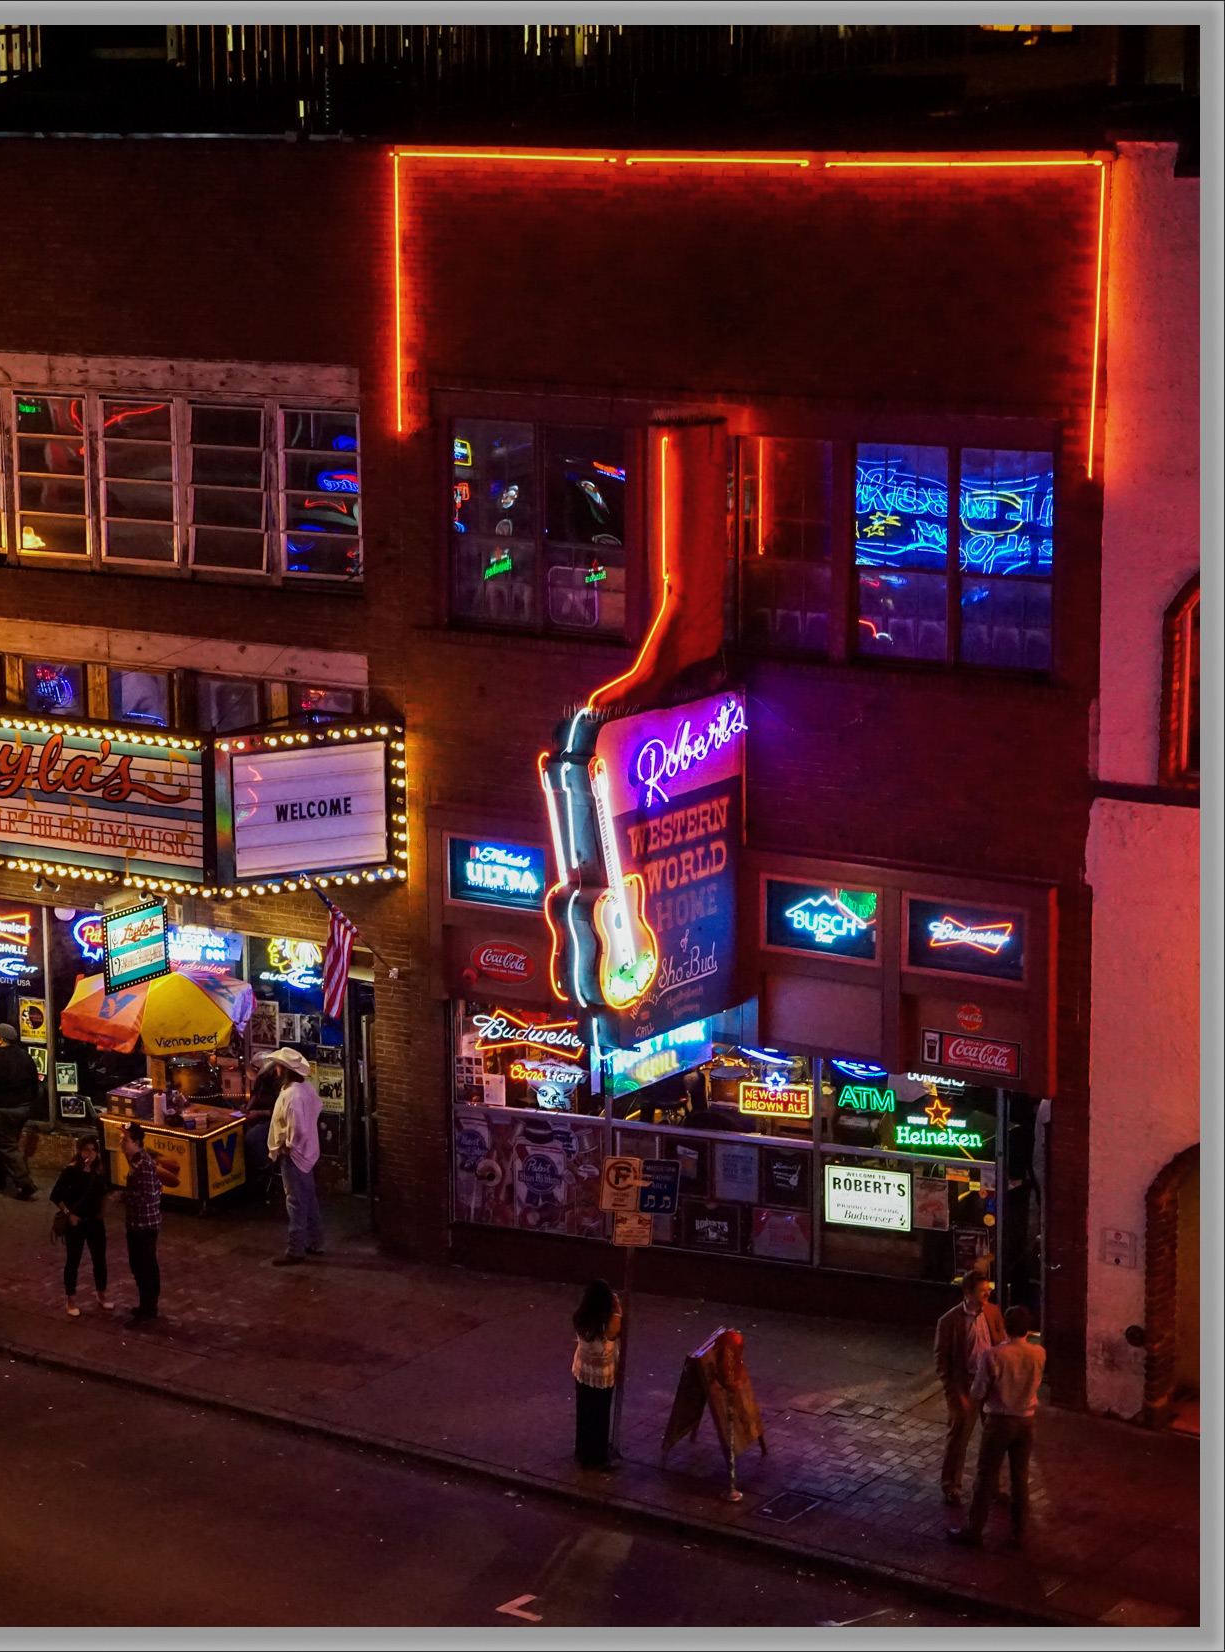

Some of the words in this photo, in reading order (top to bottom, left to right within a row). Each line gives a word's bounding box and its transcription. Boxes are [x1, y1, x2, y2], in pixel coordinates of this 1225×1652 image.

[637, 698, 749, 807] Robert's
[275, 797, 352, 822] WELCOME
[29, 812, 124, 847] HILLBILLY
[127, 825, 195, 859] MUSIC
[627, 797, 731, 857] WESTERN
[465, 861, 539, 892] ULTRA
[643, 840, 727, 894] WORLD
[655, 883, 718, 933] HOME
[793, 910, 857, 937] BUSCH
[929, 922, 1011, 946] Budweiser
[679, 928, 690, 953] of
[3, 961, 39, 974] LIGHT
[169, 960, 231, 975] Budweiser
[479, 948, 527, 971] Coca-Cola
[658, 942, 717, 989] Sho-Bud
[0, 976, 15, 985] CITY
[17, 978, 31, 987] USA
[259, 971, 289, 982] BUD
[291, 974, 325, 985] LIGH
[155, 1037, 191, 1049] Vienna
[193, 1032, 218, 1046] Beef
[473, 1014, 585, 1048] Budweise
[948, 1038, 1011, 1068] Coca-Cola
[510, 1064, 545, 1081] Coors
[545, 1072, 584, 1084] LIGHT
[635, 1050, 679, 1082] GRILL
[745, 1088, 807, 1104] NEWCASTLE
[745, 1099, 784, 1113] BROWN
[787, 1102, 807, 1114] ALE
[837, 1085, 895, 1112] ATM
[895, 1126, 983, 1148] Heineken
[527, 1158, 552, 1174] Pabst
[845, 1171, 875, 1180] WELCOME
[832, 1176, 906, 1198] ROBERT'S
[843, 1210, 894, 1224] Budweiser
